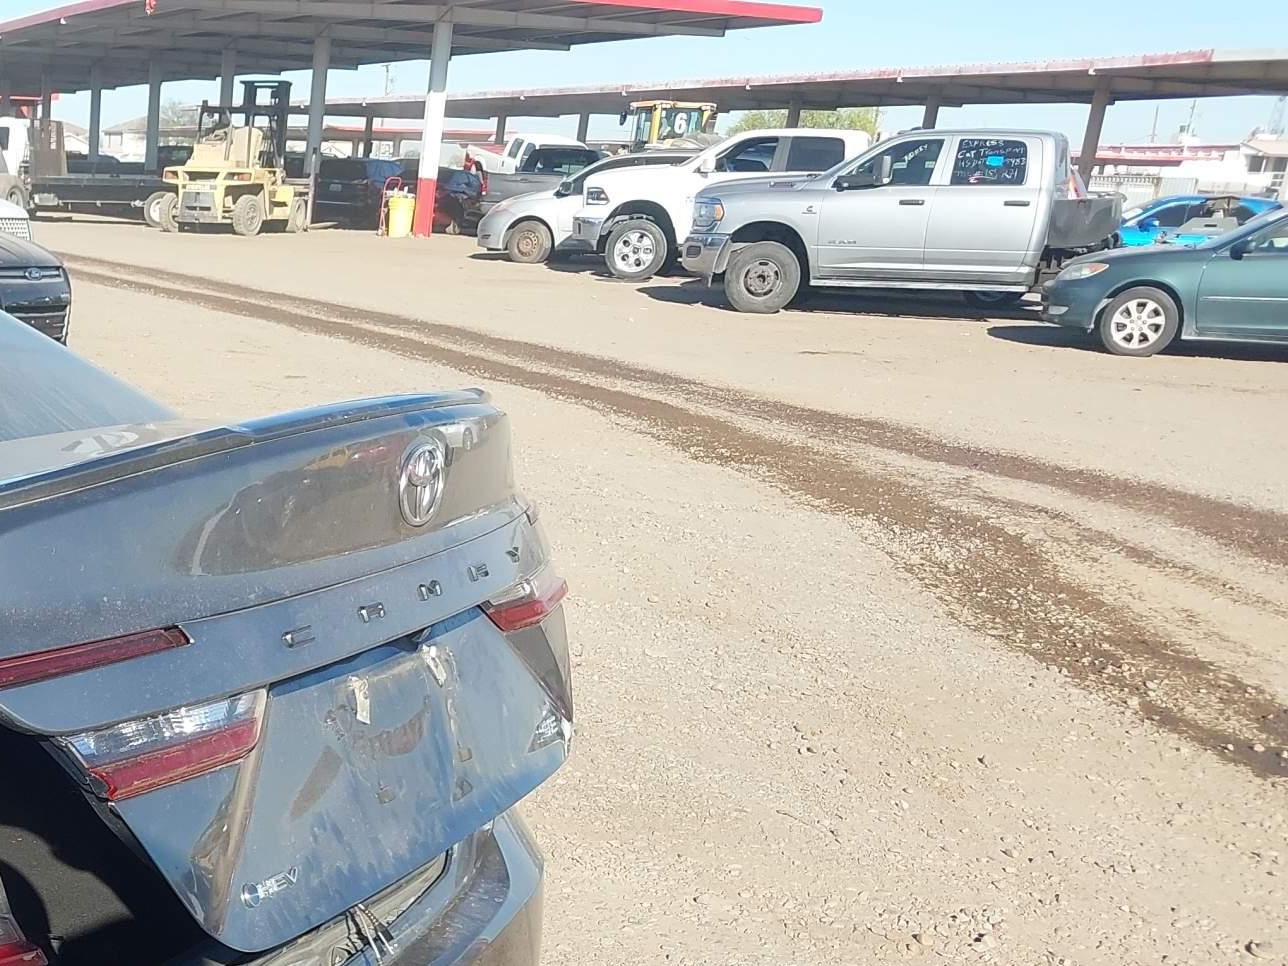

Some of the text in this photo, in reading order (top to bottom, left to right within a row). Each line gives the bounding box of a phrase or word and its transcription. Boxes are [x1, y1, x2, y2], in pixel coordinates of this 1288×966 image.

[674, 112, 688, 134] 6
[280, 546, 520, 649] CAMRY
[256, 865, 298, 900] HEV
